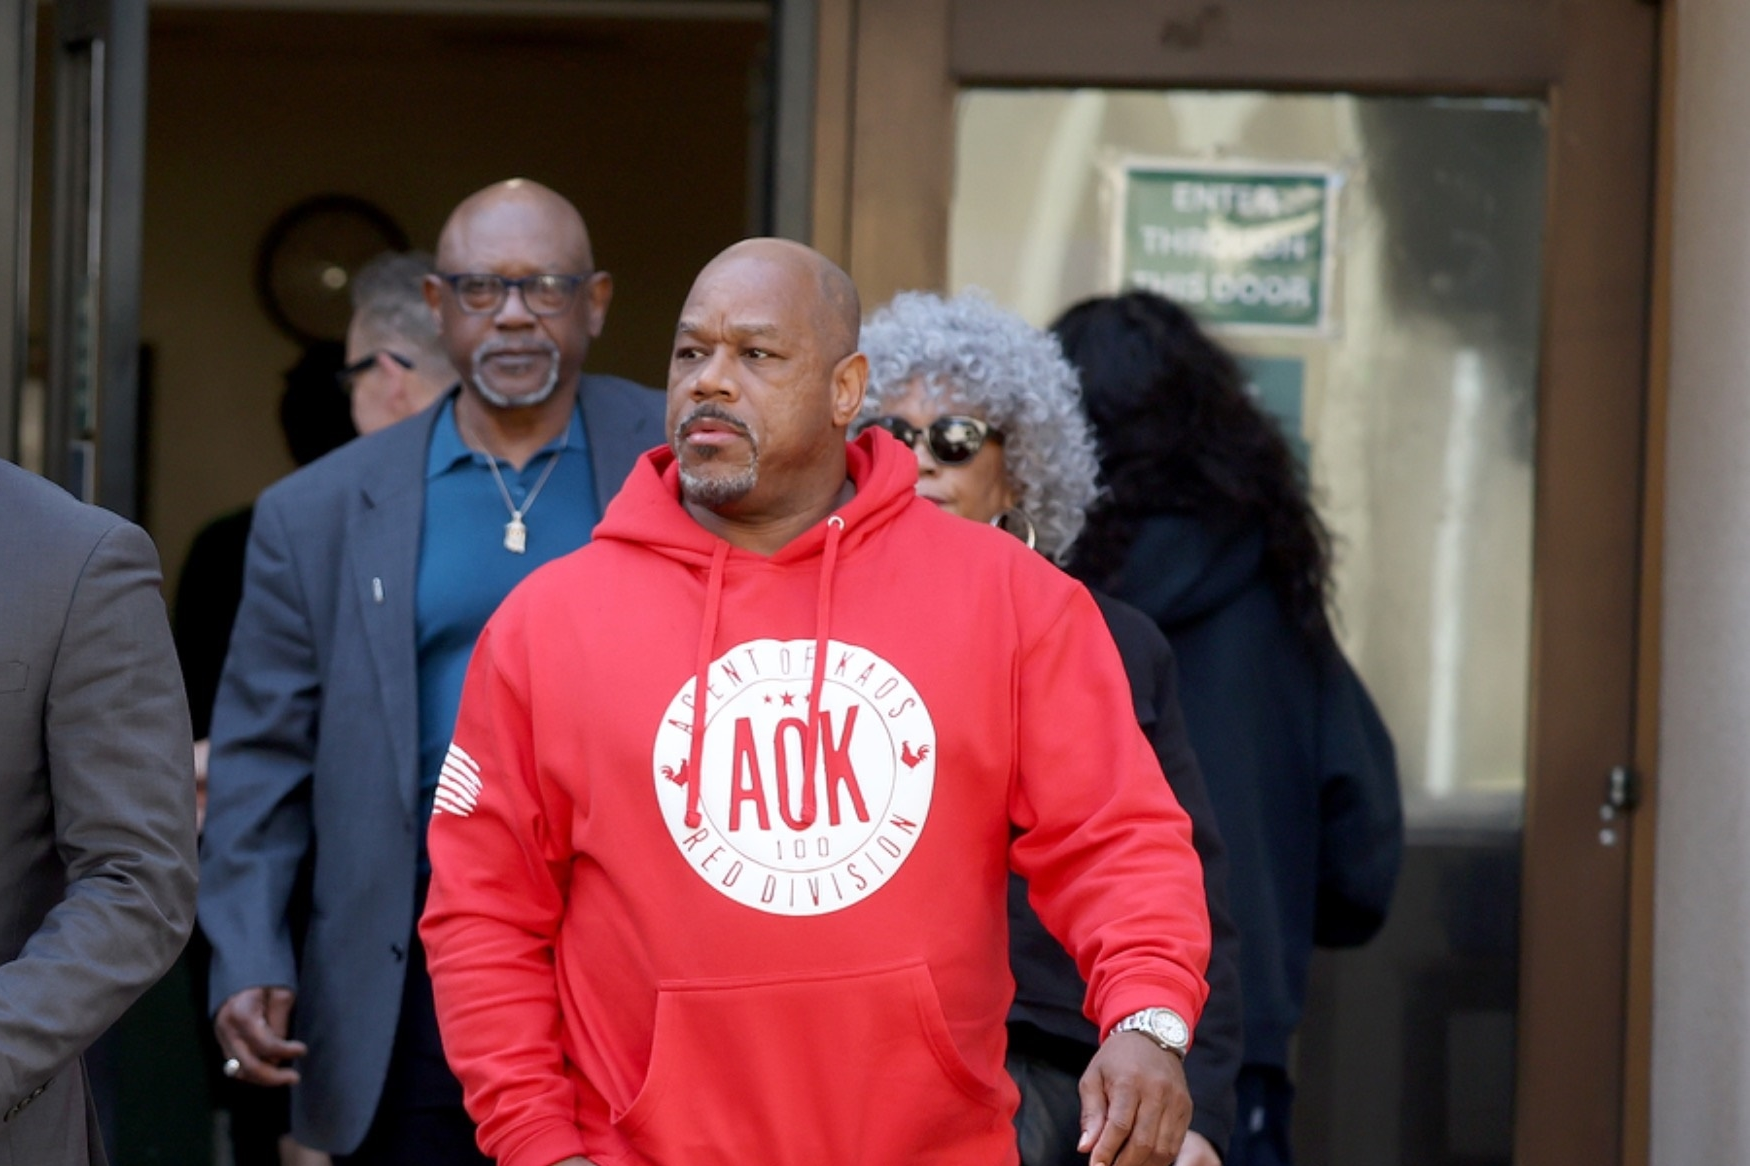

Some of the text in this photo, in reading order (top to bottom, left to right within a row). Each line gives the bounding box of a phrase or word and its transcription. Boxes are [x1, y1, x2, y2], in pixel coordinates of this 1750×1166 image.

[1140, 226, 1308, 261] THRGH
[1210, 272, 1312, 308] DOOR
[780, 646, 816, 676] OF
[834, 650, 916, 719] KAOS
[728, 704, 871, 833] AOK
[682, 813, 918, 908] RED DIVISION
[776, 836, 830, 861] 100
